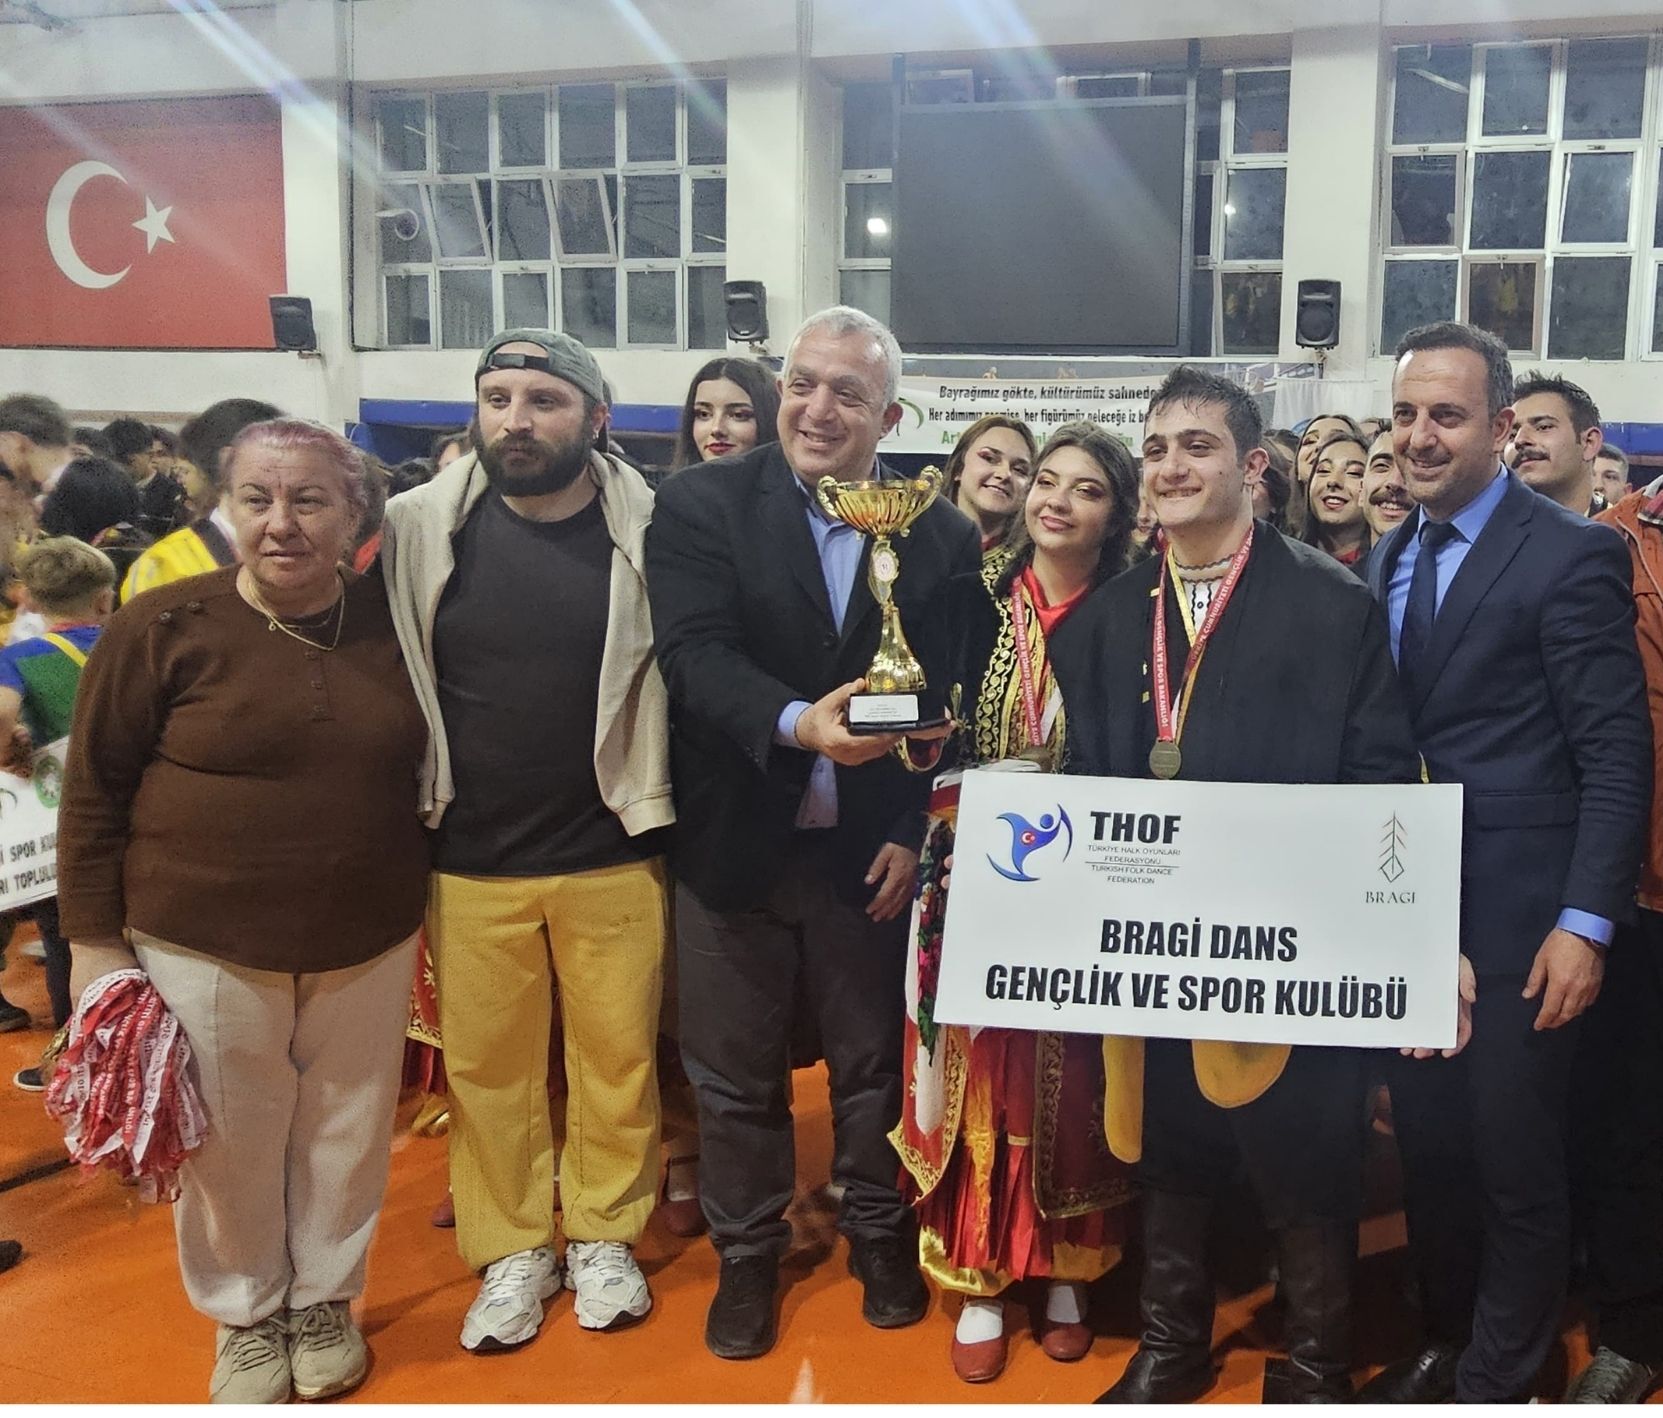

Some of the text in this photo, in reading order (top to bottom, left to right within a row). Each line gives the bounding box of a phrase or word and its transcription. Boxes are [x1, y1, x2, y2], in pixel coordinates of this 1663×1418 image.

[1090, 810, 1181, 844] THOF
[1107, 875, 1155, 884] FEDERATION
[1365, 891, 1416, 905] BRAGI
[1100, 917, 1299, 962] BRAGİ DANS
[985, 963, 1408, 1021] GENÇLİK VE SPOR KULÜBÜ
